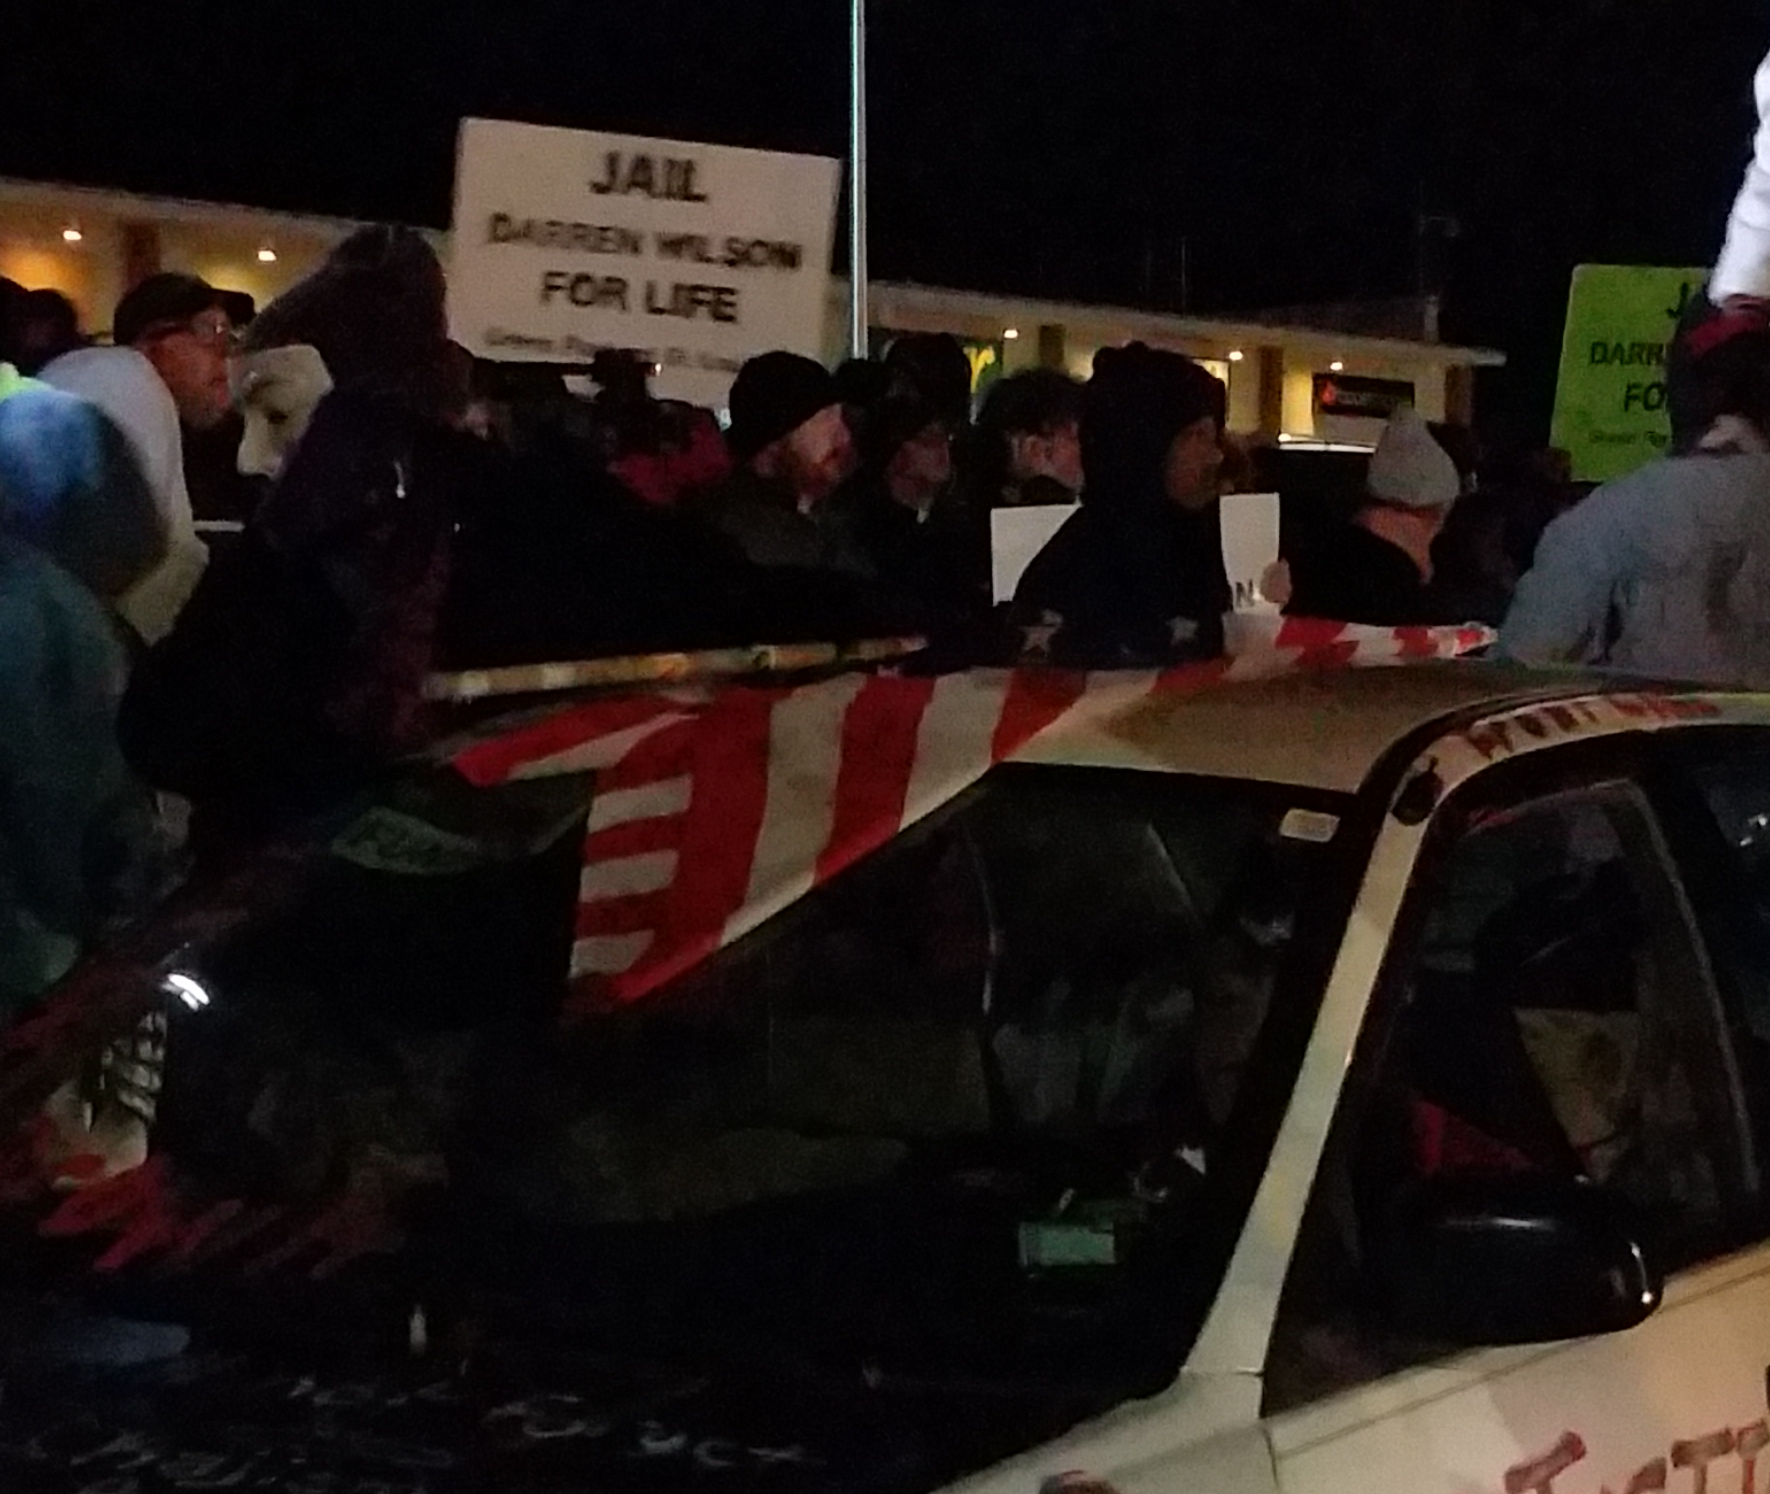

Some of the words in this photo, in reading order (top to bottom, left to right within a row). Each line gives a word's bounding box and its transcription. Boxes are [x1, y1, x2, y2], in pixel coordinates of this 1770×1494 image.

[588, 149, 709, 203] JAIL
[488, 211, 643, 256] DARREN
[656, 231, 803, 270] WILSON
[541, 270, 627, 312] FOR
[645, 280, 740, 323] LIFE
[1588, 340, 1667, 366] DARR
[1624, 381, 1666, 412] FO
